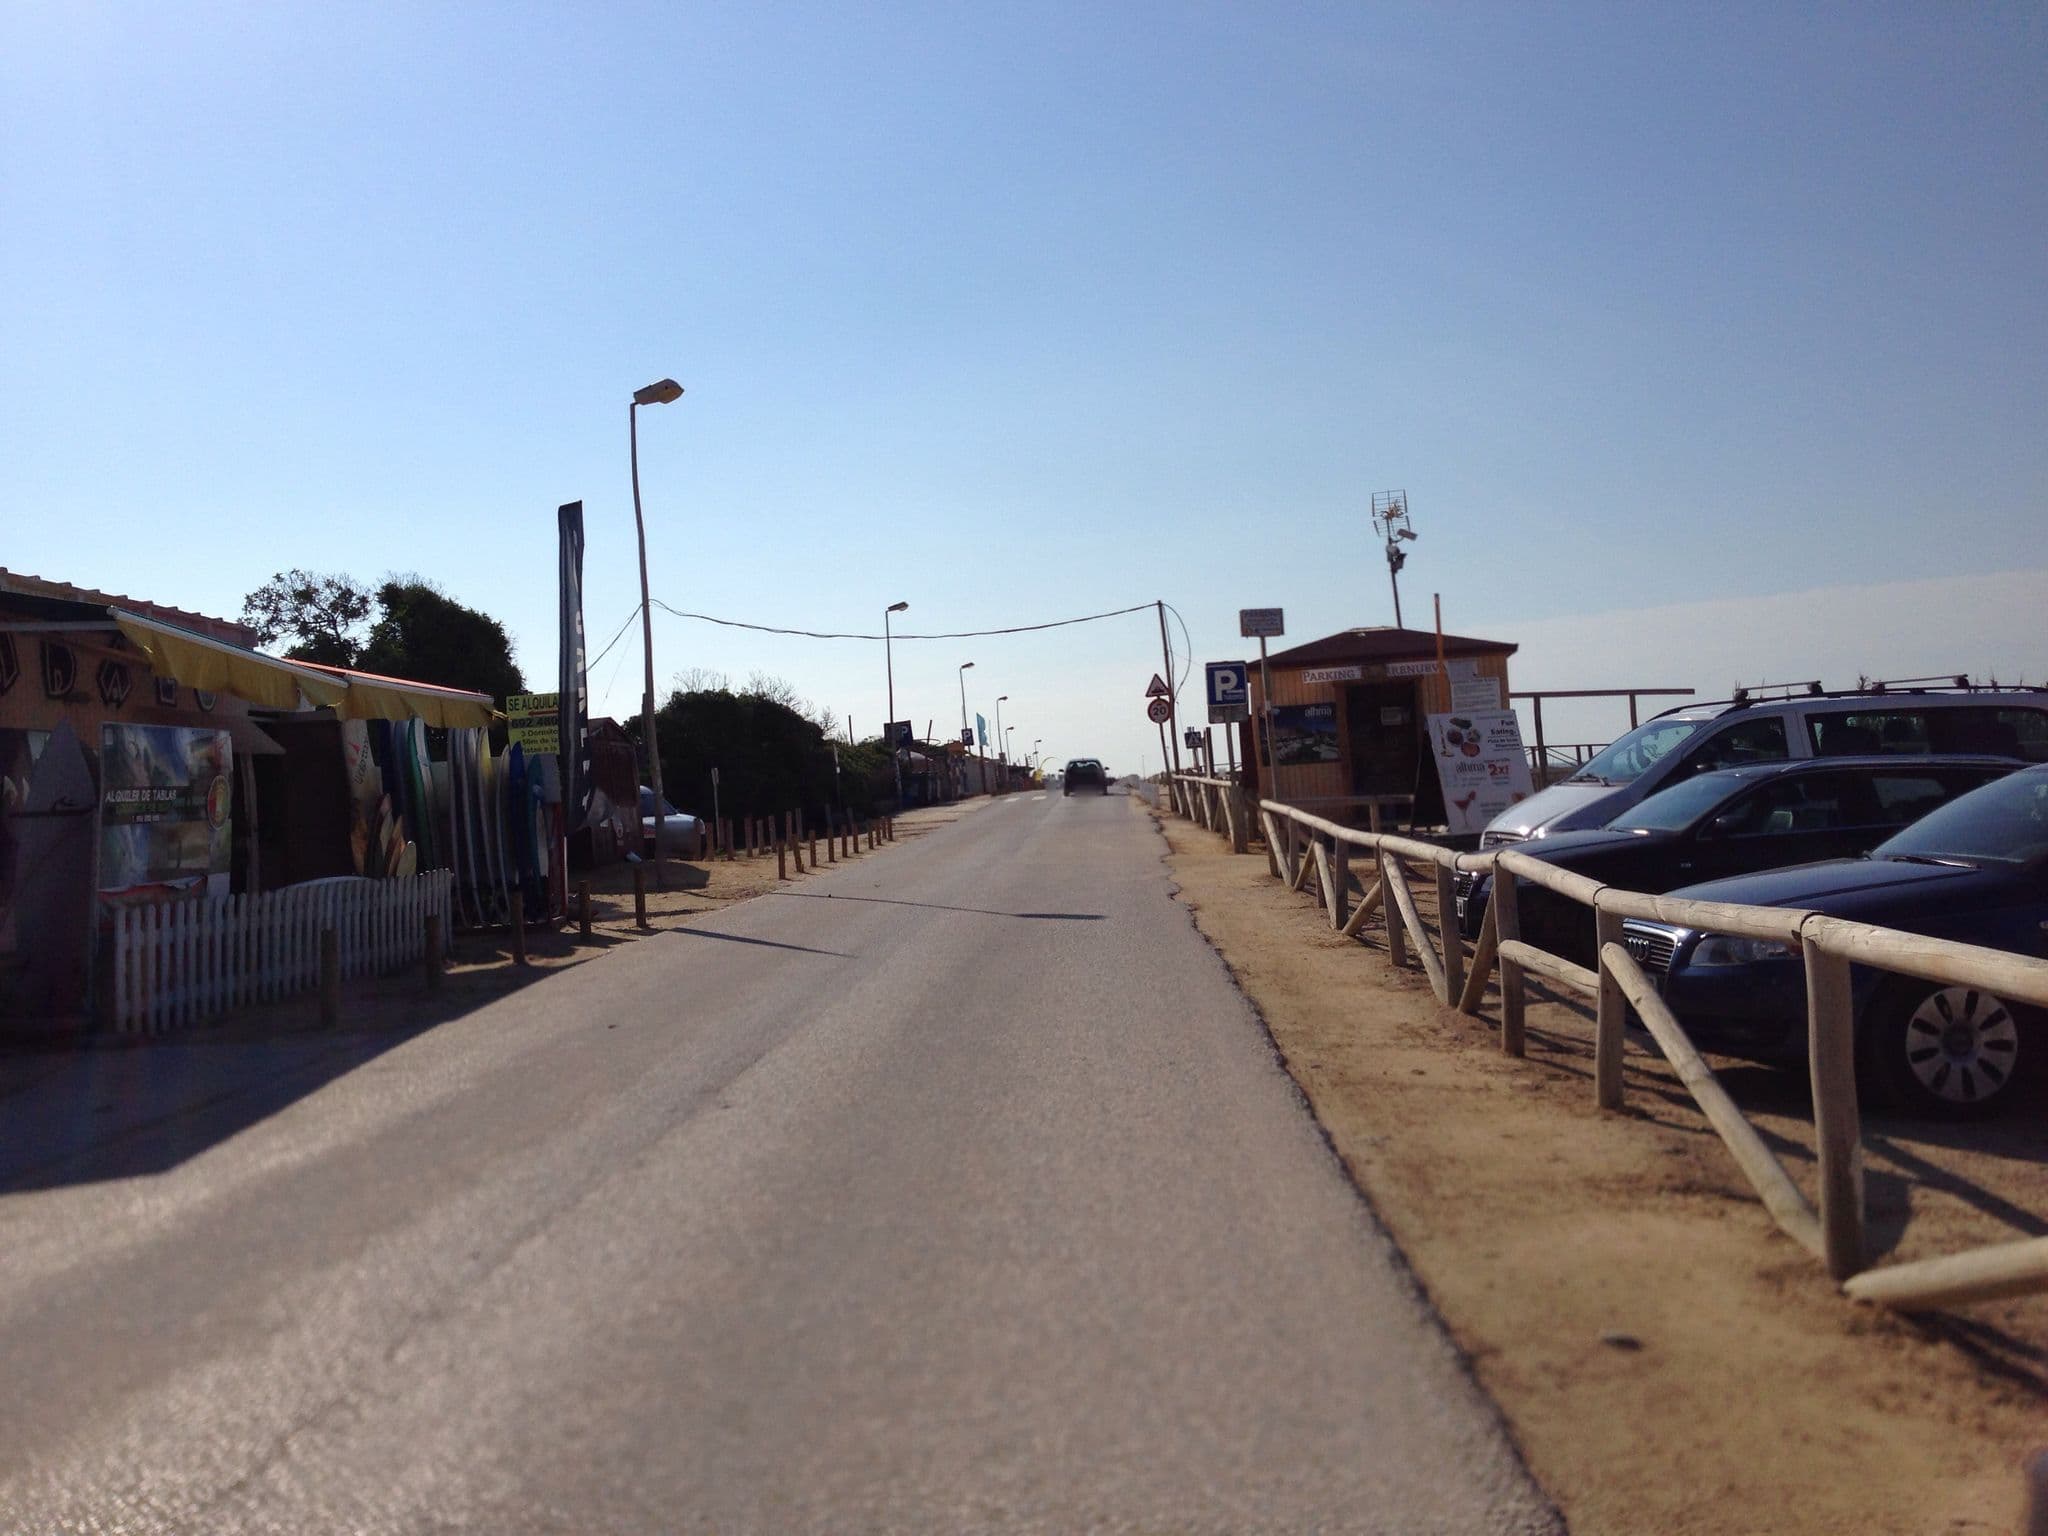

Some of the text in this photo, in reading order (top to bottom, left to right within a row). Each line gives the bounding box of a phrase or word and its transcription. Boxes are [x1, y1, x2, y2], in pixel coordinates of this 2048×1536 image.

[1302, 668, 1356, 683] PARKING
[1214, 669, 1238, 702] P
[508, 696, 558, 711] SE ALQUILA
[1152, 706, 1167, 716] 20
[901, 726, 908, 736] P
[963, 730, 971, 740] P
[141, 790, 151, 802] DE
